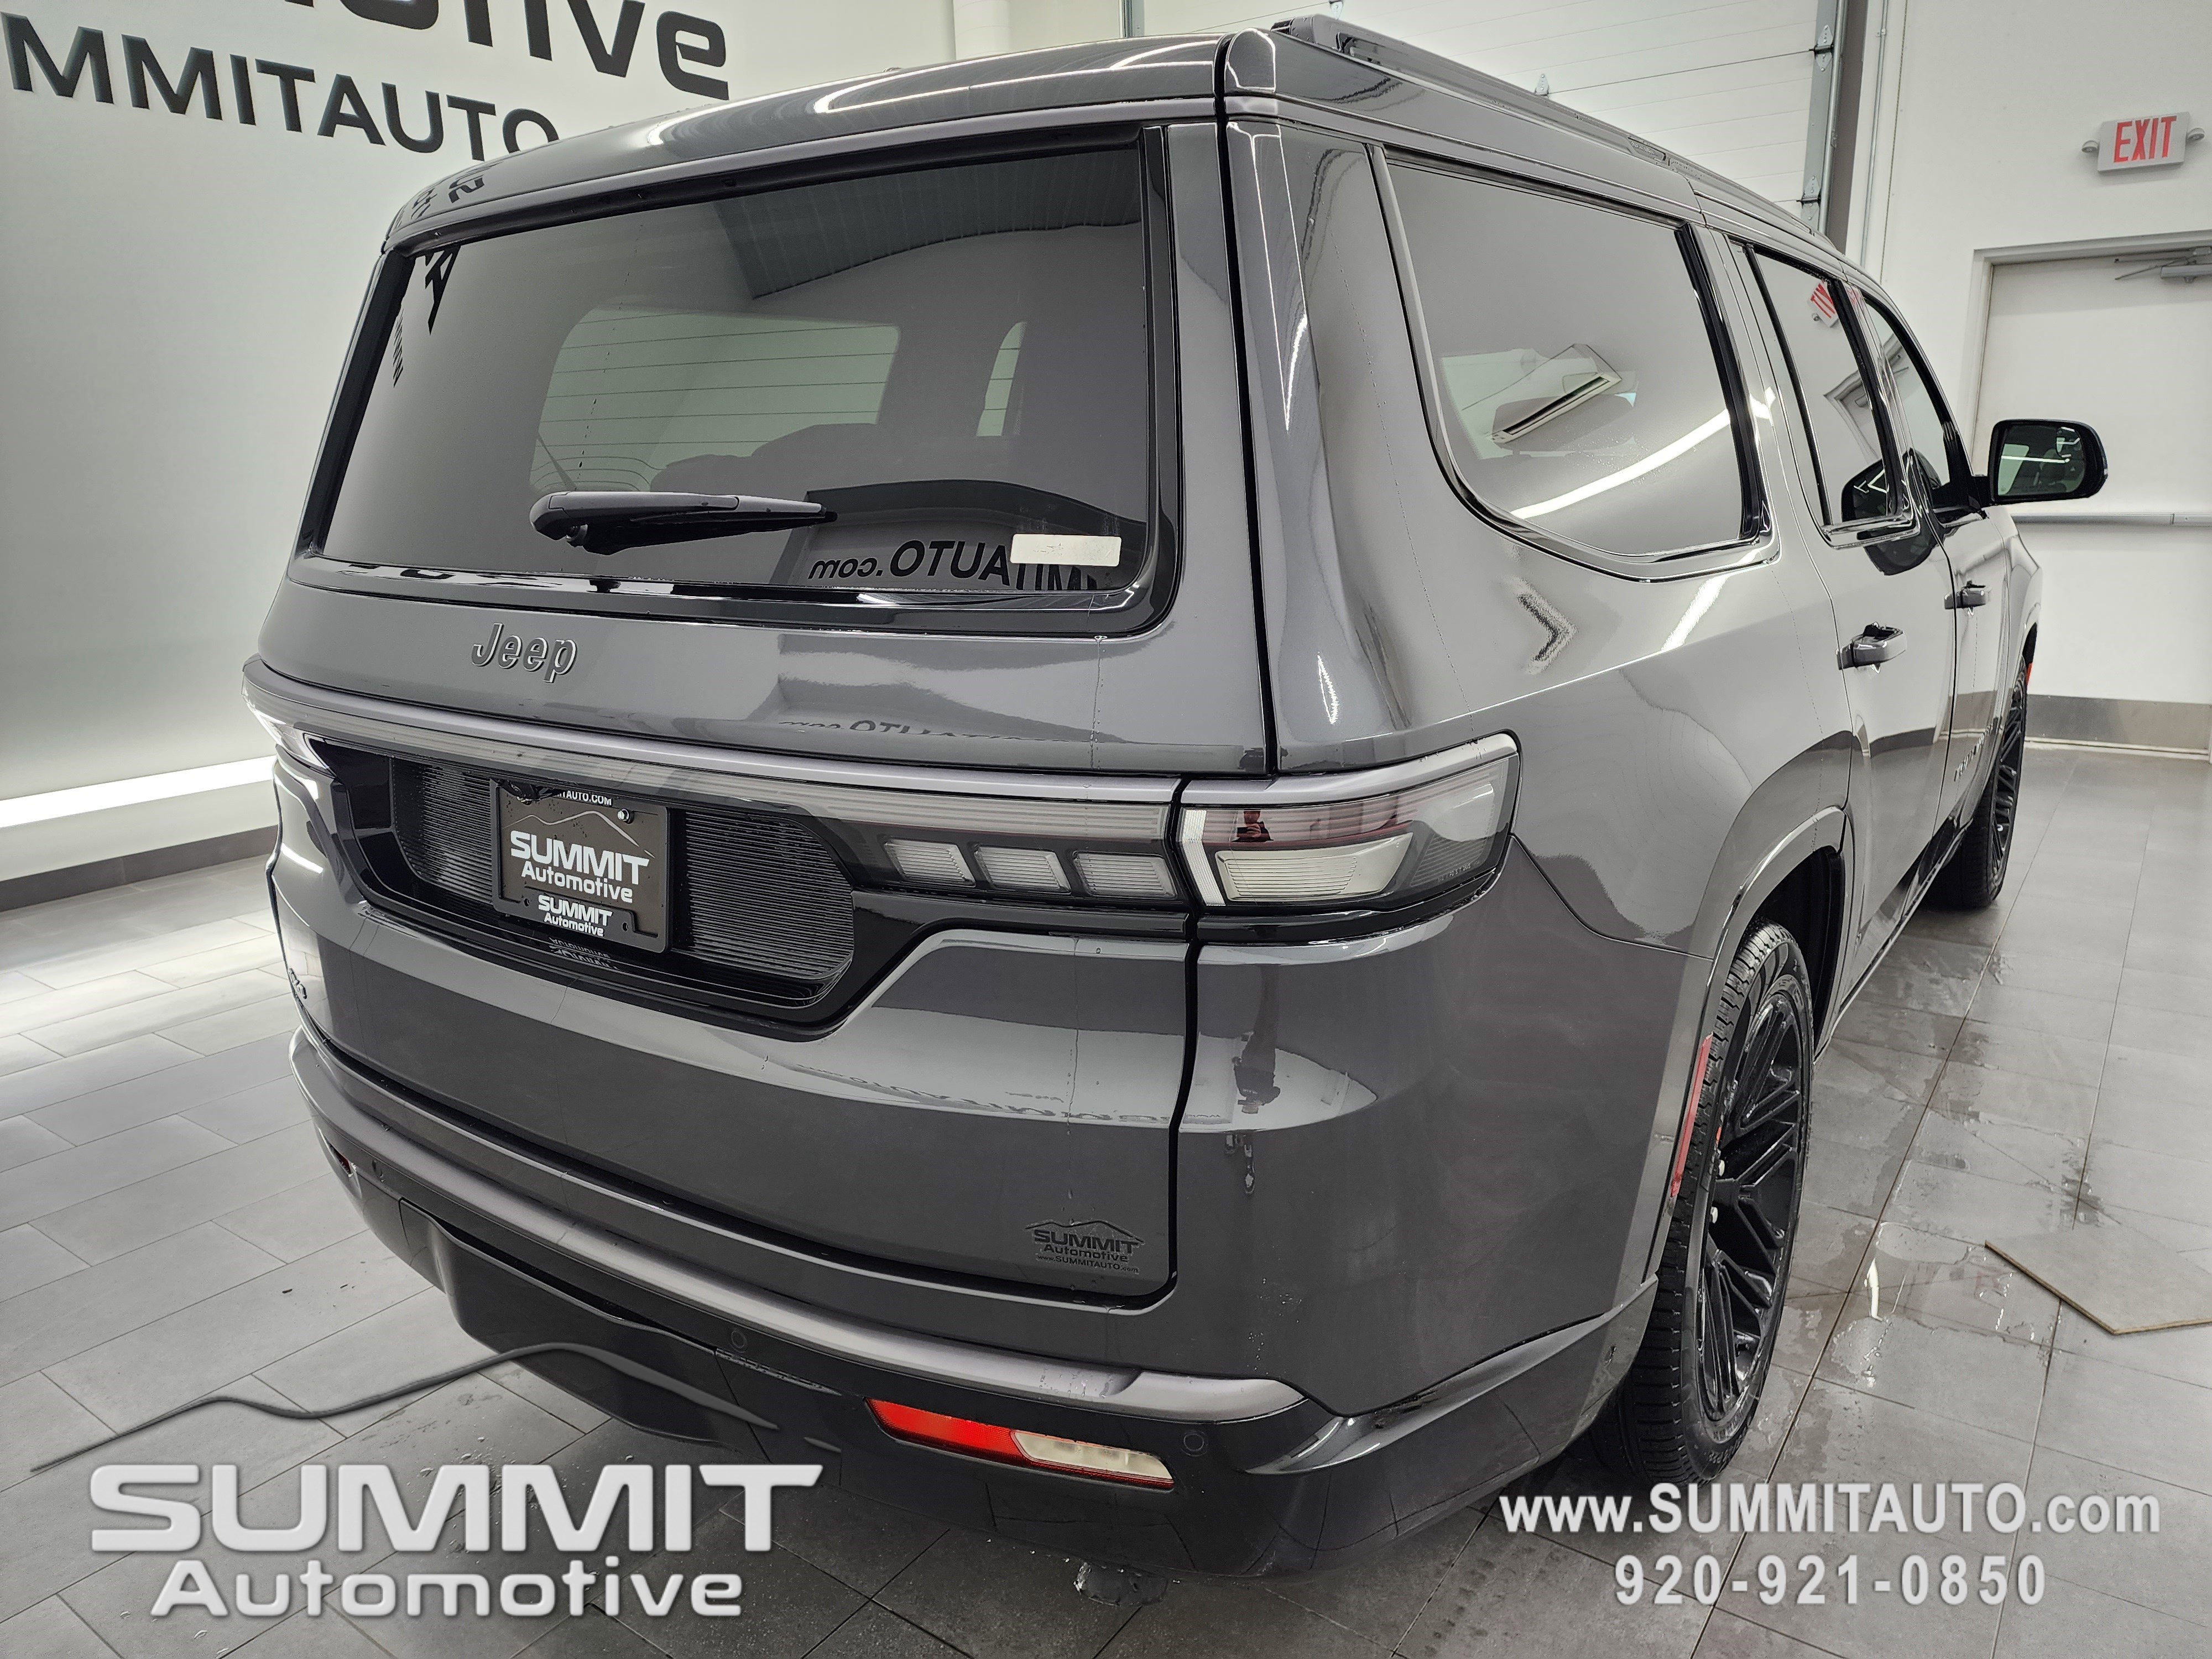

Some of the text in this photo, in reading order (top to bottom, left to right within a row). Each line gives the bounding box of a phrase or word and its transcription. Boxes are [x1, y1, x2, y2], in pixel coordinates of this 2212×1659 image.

[0, 11, 559, 161] MMITAUTO
[2114, 115, 2177, 163] EXIT
[471, 623, 576, 683] Jeep
[510, 830, 649, 885] SUMMIT
[521, 860, 633, 903] Automotive
[538, 894, 613, 926] SUMMIT
[544, 912, 604, 937] Automotive
[1034, 1229, 1138, 1254] SUMMIT
[1044, 1244, 1128, 1262] Automotive
[1037, 1255, 1138, 1272] www.SUMMITAUTO.com
